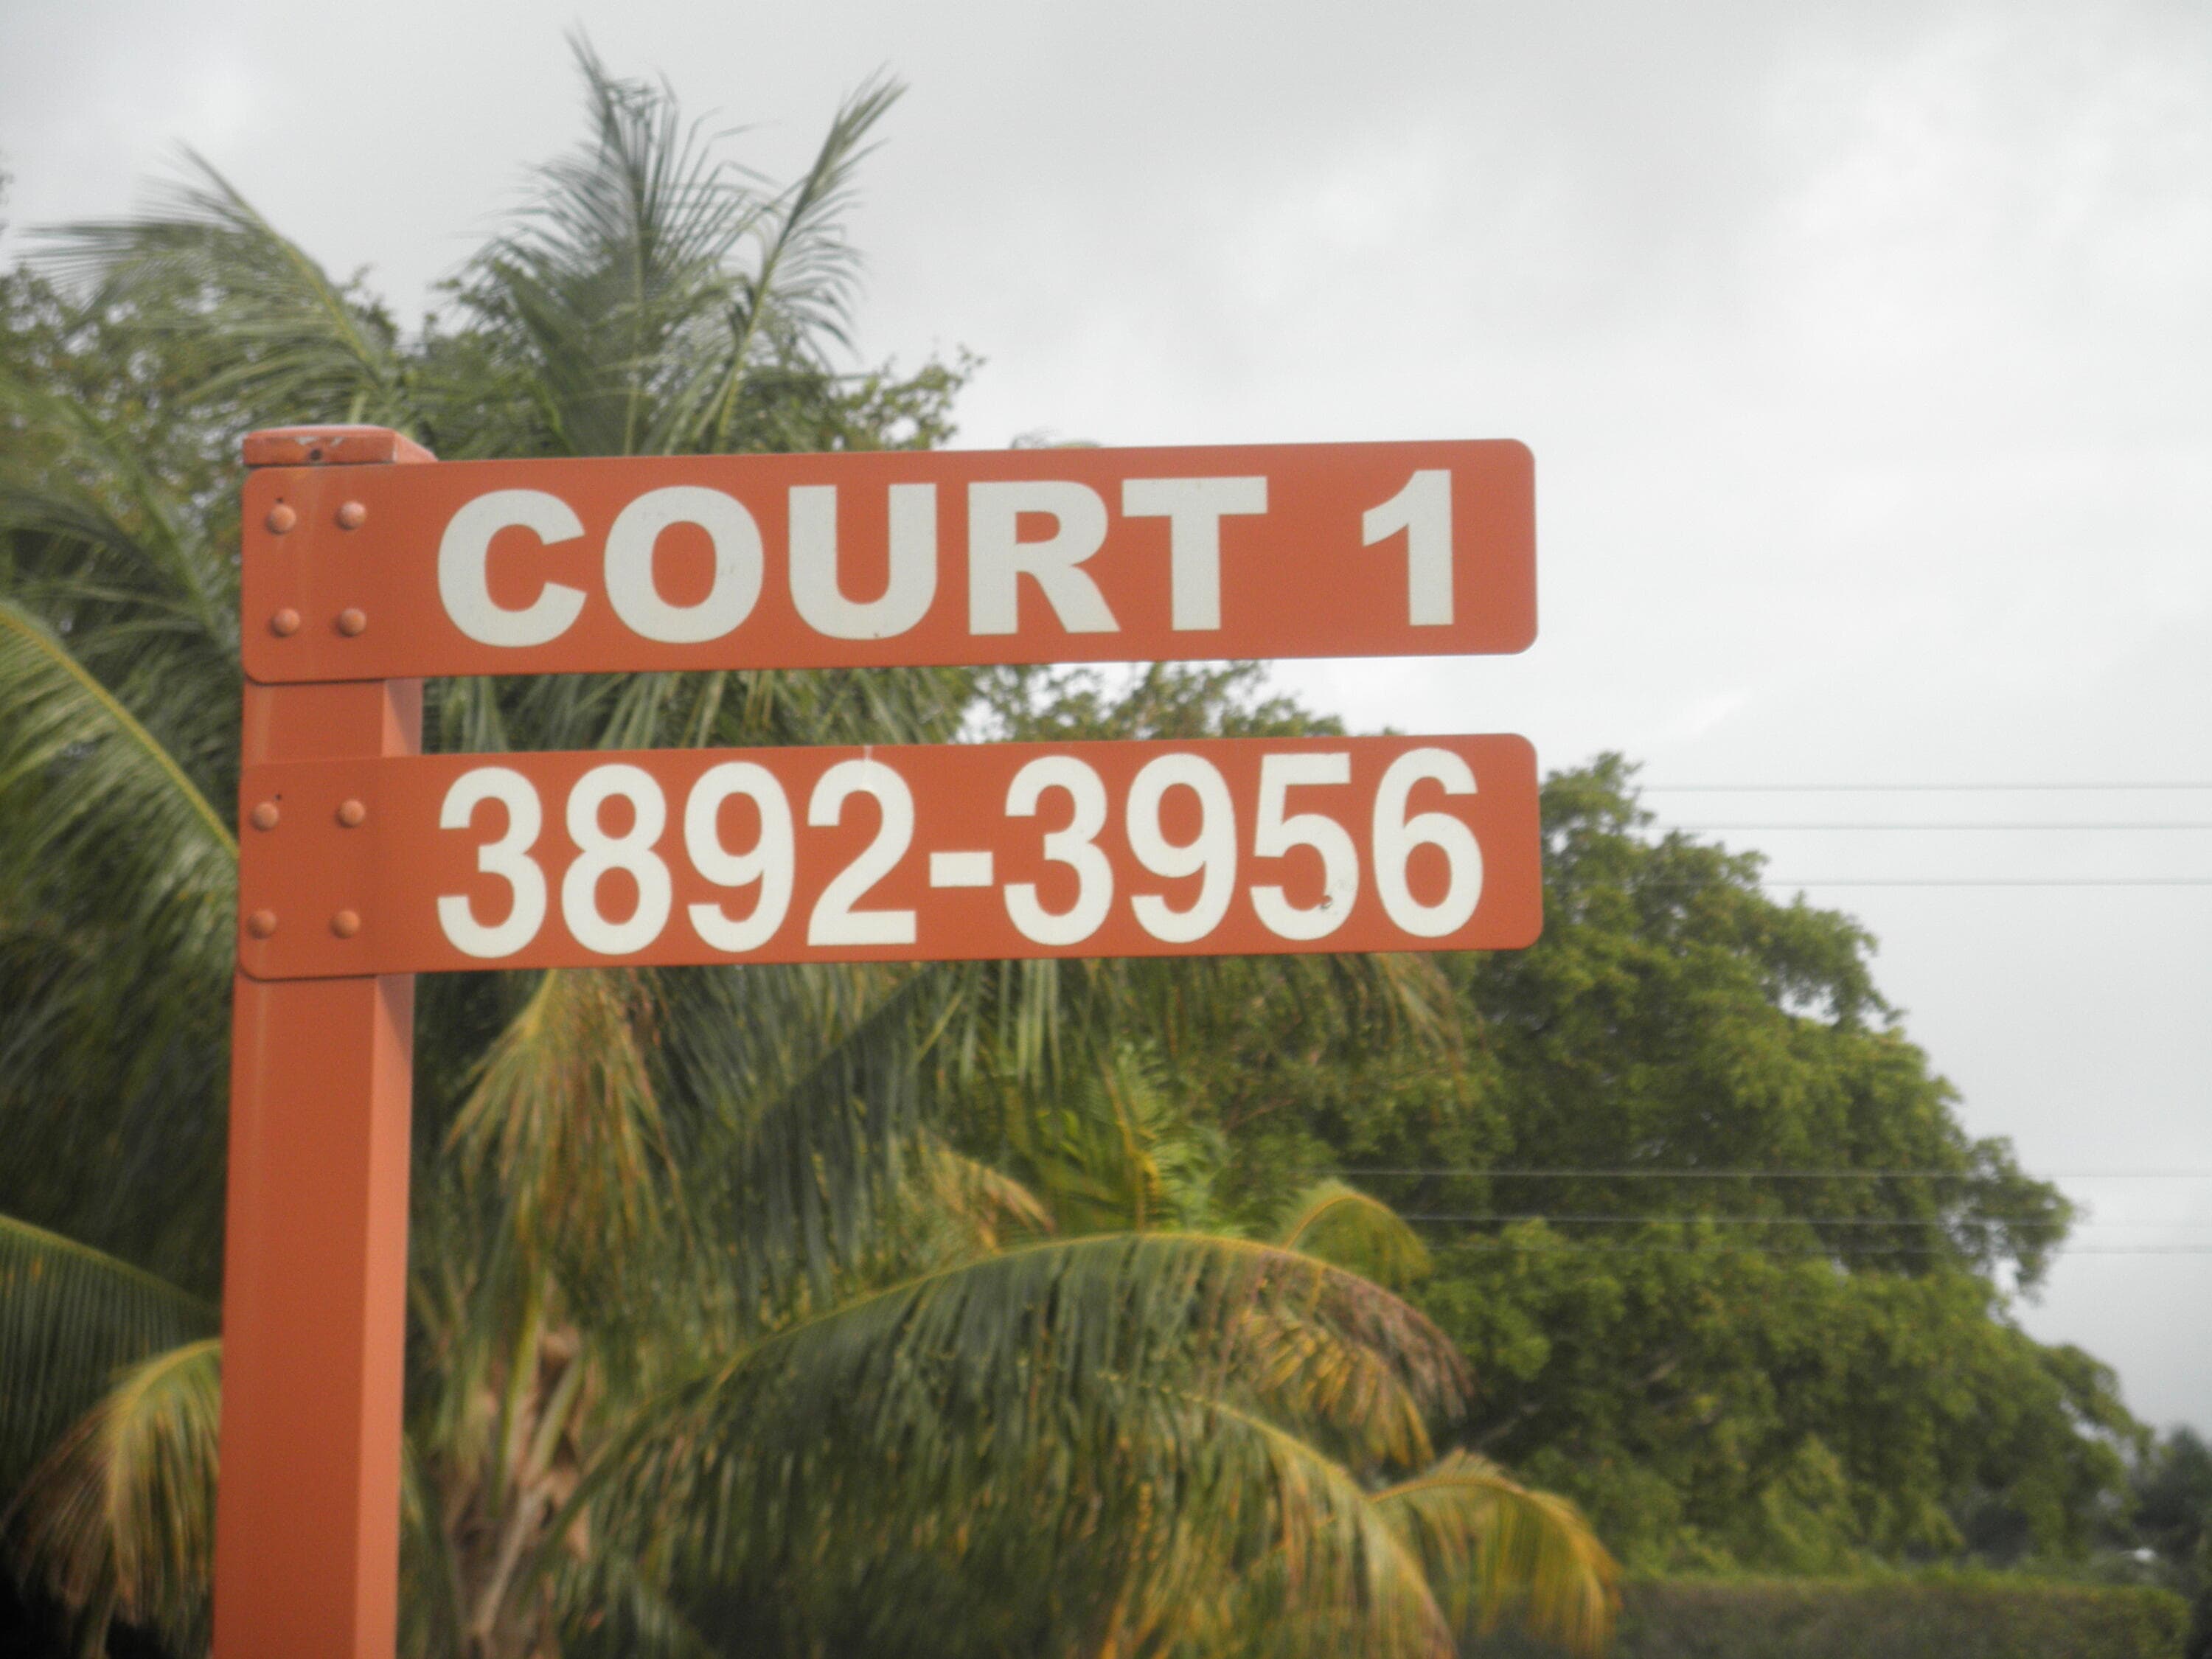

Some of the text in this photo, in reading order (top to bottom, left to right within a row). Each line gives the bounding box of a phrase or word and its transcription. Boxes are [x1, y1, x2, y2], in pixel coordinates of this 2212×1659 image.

[437, 468, 1454, 648] COURT 1
[437, 745, 1484, 959] 3892-3956
